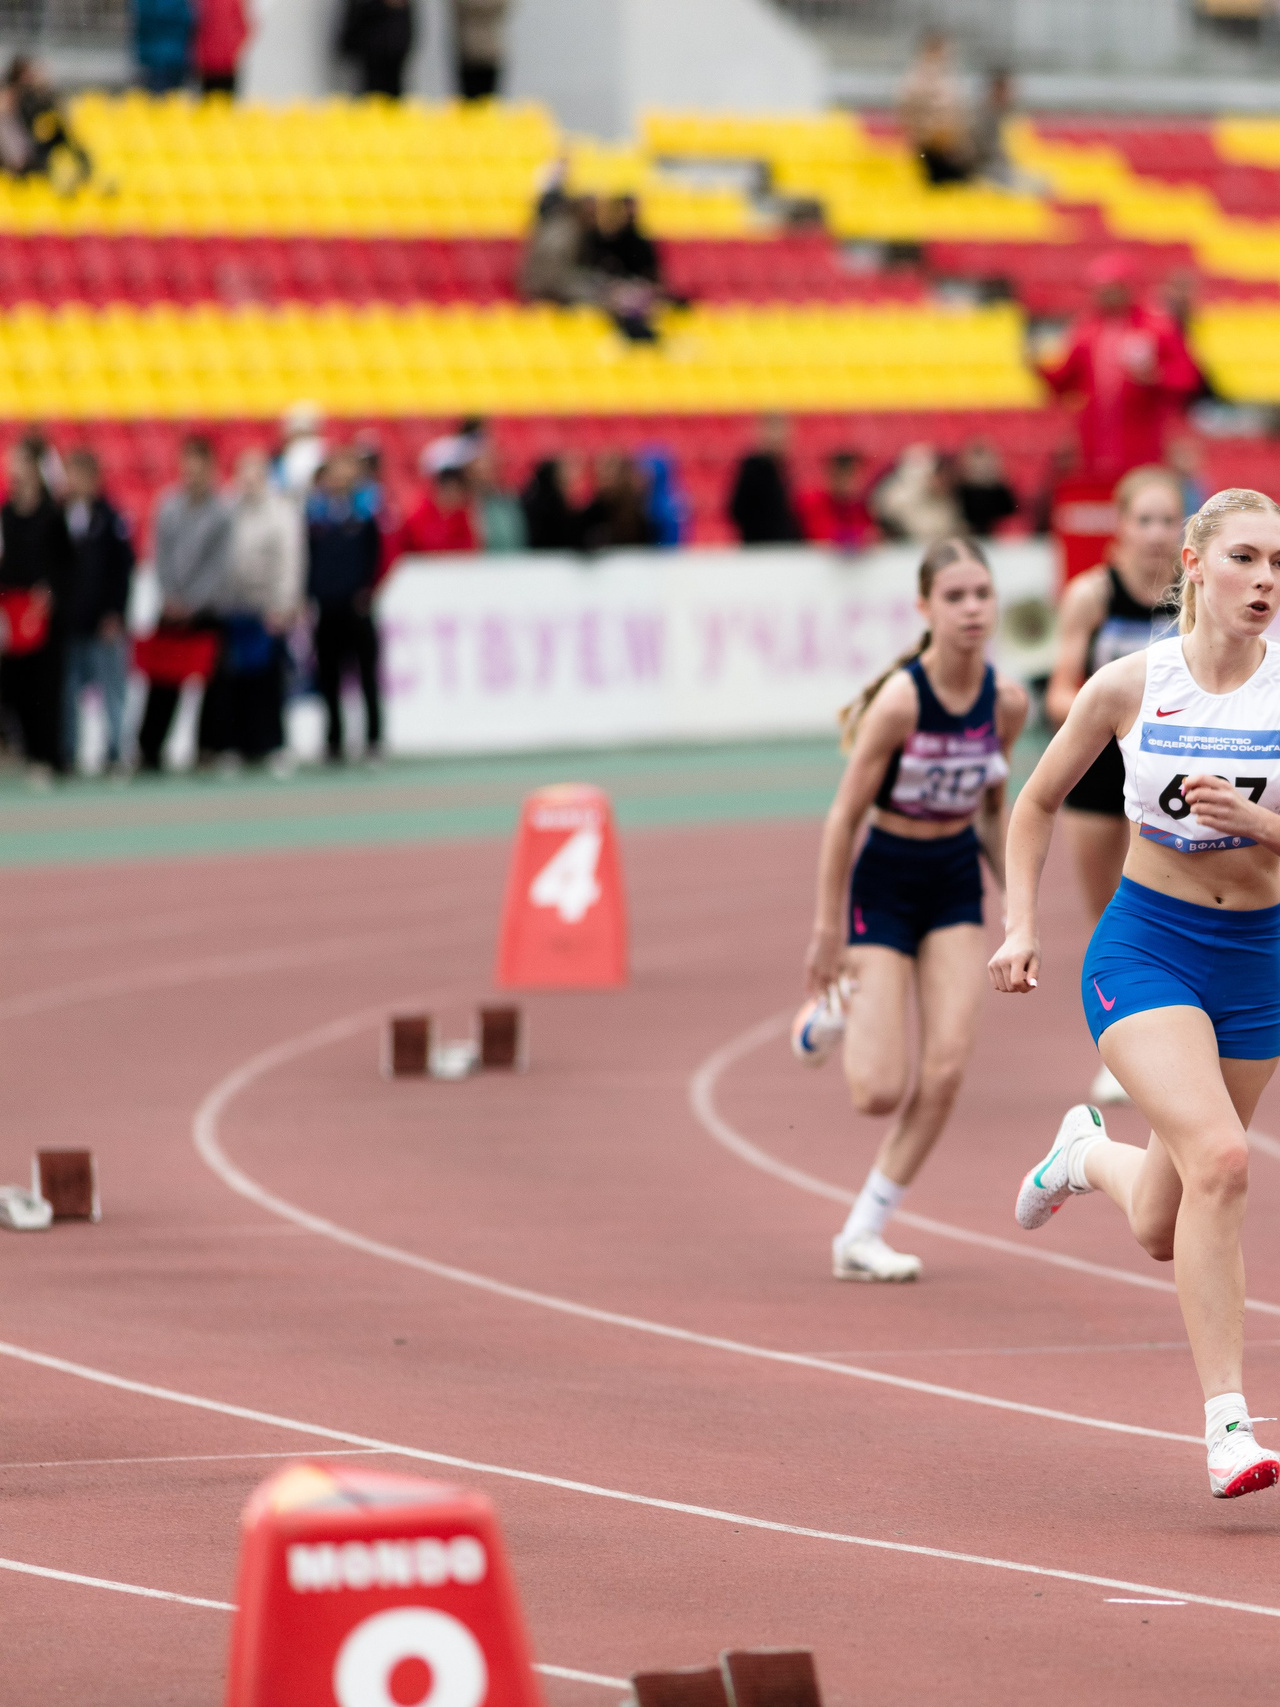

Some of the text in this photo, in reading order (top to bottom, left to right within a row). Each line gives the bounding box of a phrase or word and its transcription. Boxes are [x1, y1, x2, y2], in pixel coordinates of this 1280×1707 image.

[1148, 738, 1280, 752] ФЕДЕРАЛЬНОГО ОКРУГА
[1179, 735, 1251, 745] ПЕРВЕНСТВО
[1158, 773, 1267, 820] 67
[1189, 840, 1227, 852] ВФЛА
[529, 827, 604, 924] 4
[286, 1534, 487, 1594] MONDO
